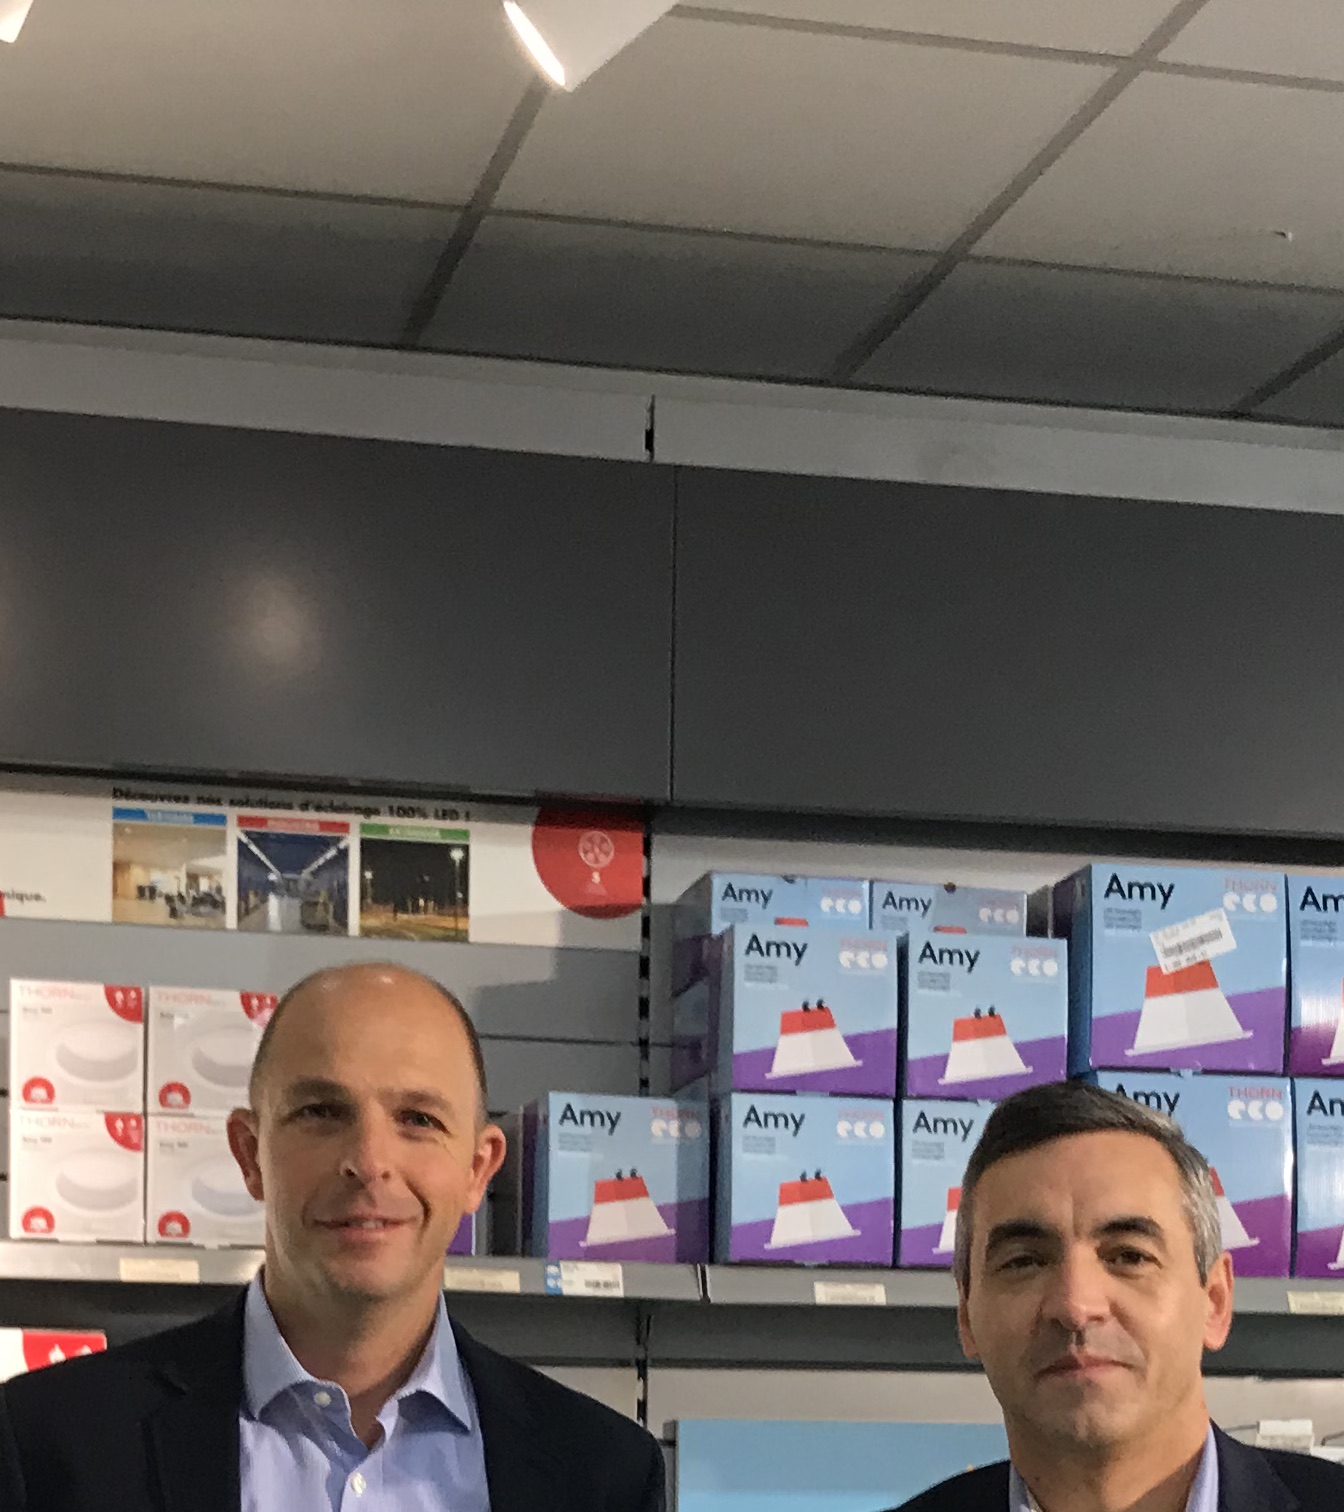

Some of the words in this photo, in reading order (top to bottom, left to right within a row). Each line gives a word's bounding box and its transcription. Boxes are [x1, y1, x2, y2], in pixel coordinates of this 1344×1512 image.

[722, 882, 773, 909] Amy
[882, 890, 932, 917] Amy
[1104, 873, 1175, 909] Amy
[745, 934, 808, 966] Amy
[918, 941, 980, 972] Amy
[559, 1102, 621, 1135] Amy
[743, 1104, 805, 1137] Amy
[912, 1110, 974, 1141] Amy
